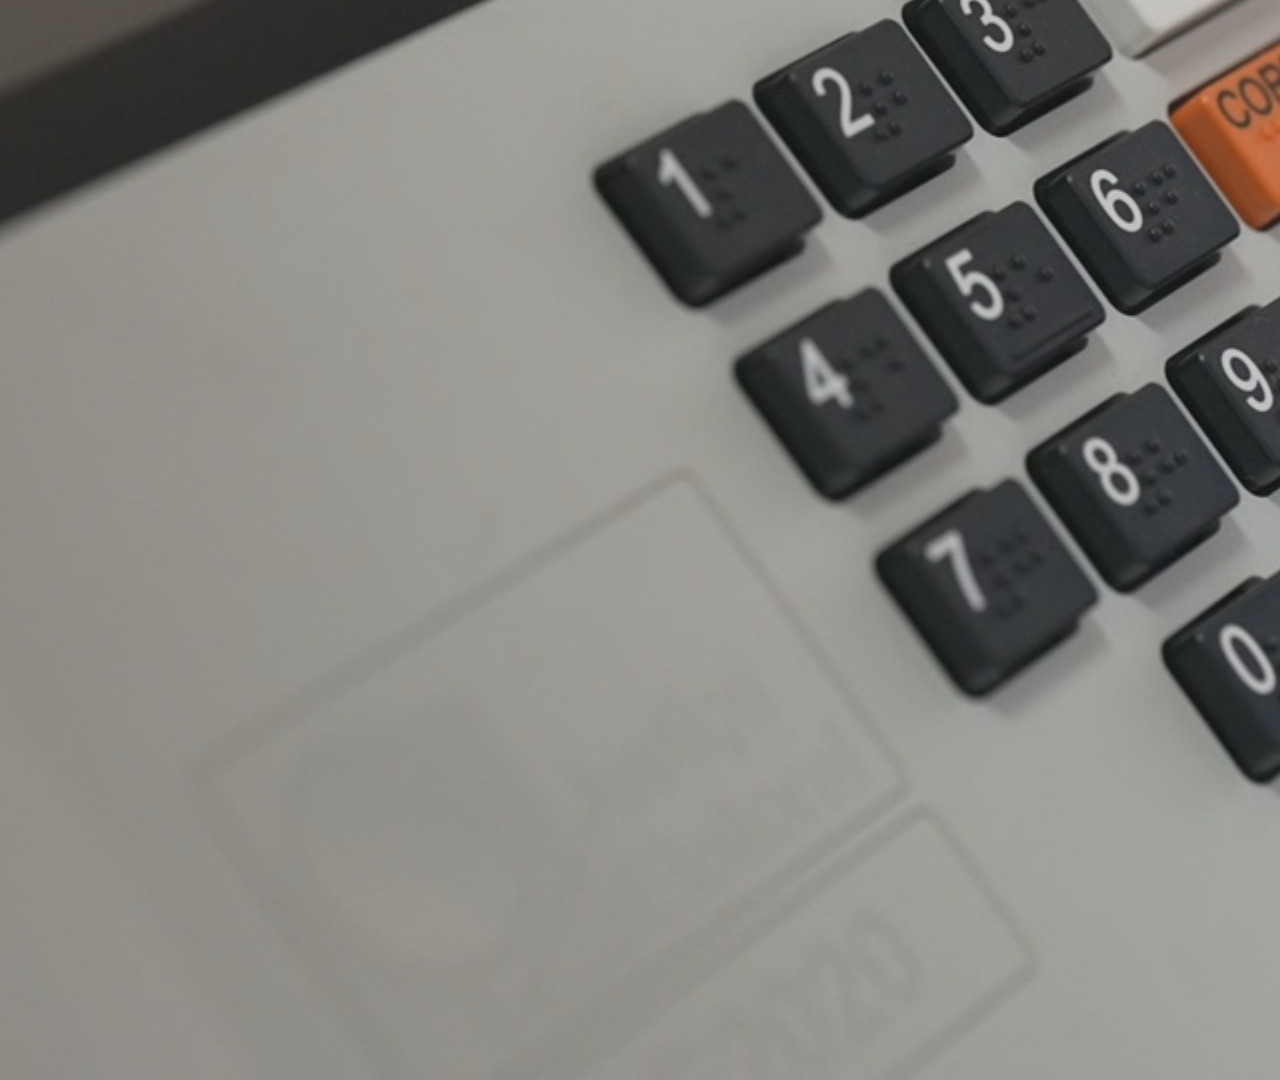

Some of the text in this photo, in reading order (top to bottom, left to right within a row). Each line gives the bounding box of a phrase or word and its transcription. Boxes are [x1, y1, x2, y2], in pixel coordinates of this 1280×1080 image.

[811, 67, 875, 138] 2
[658, 149, 712, 218] 1
[1089, 168, 1144, 233] 6
[945, 248, 1004, 321] 5
[799, 338, 852, 409] 4
[1220, 347, 1274, 413] 9
[1082, 436, 1141, 507] 8
[925, 530, 986, 611] 7
[1219, 624, 1277, 695] 0
